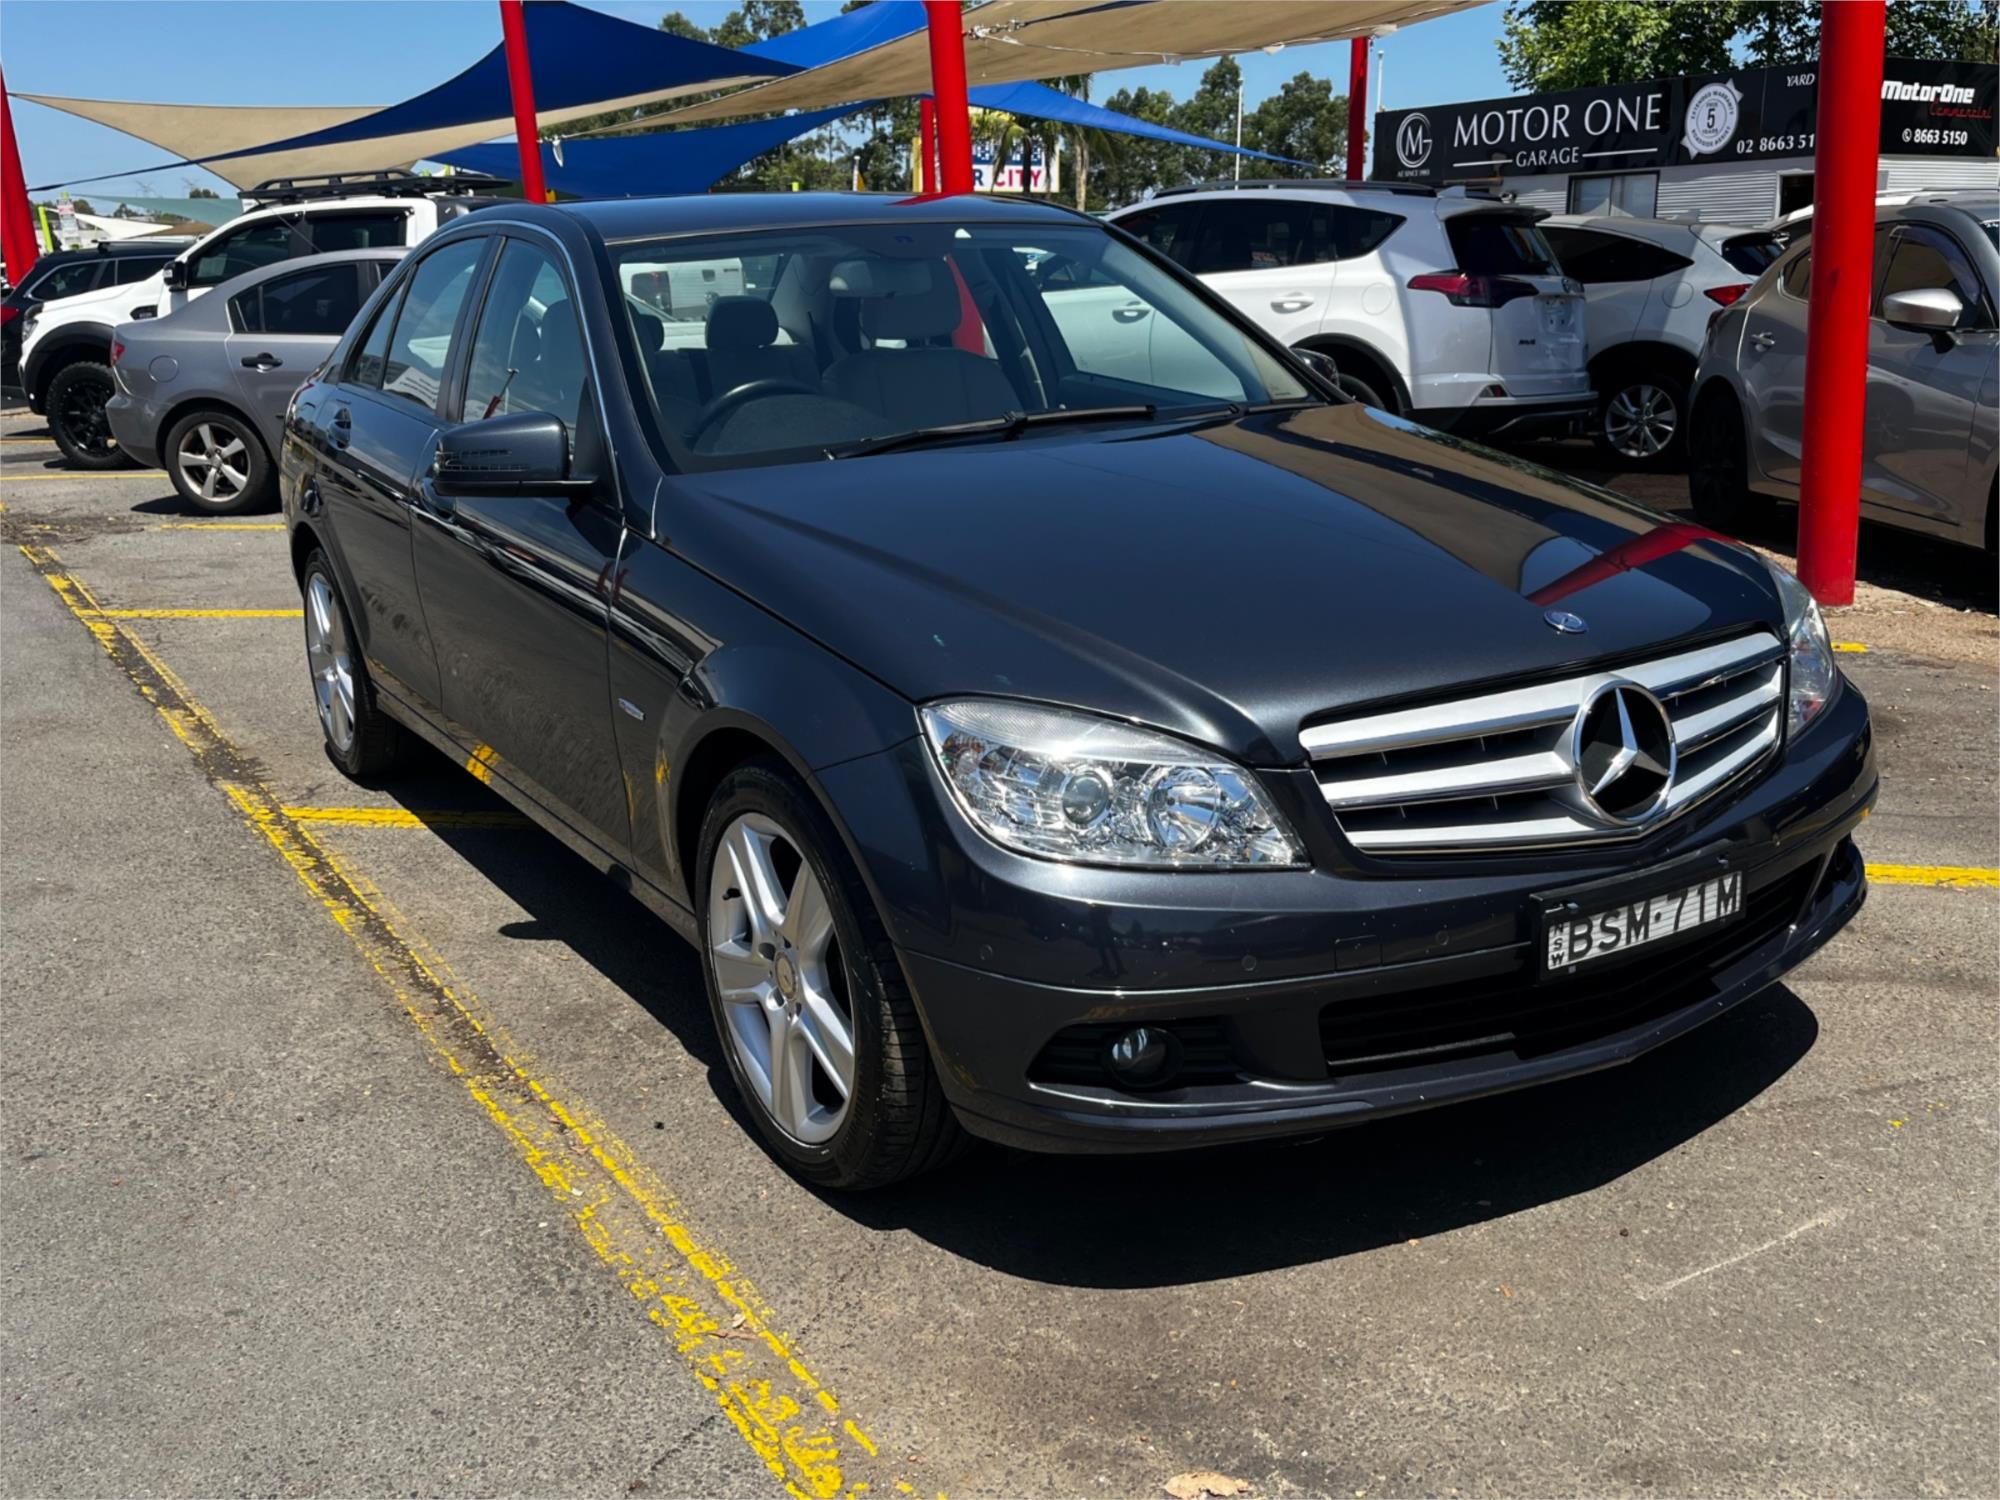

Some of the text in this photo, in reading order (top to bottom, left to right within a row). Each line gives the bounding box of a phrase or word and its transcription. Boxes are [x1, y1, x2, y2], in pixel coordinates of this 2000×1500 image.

[1786, 73, 1815, 87] YARD
[1453, 93, 1662, 147] MOTOR ONE
[1707, 108, 1715, 129] 5
[1736, 139, 1754, 154] 02
[1759, 135, 1794, 152] 8663
[1914, 128, 1968, 145] 8663 5150
[1515, 147, 1580, 167] GARAGE
